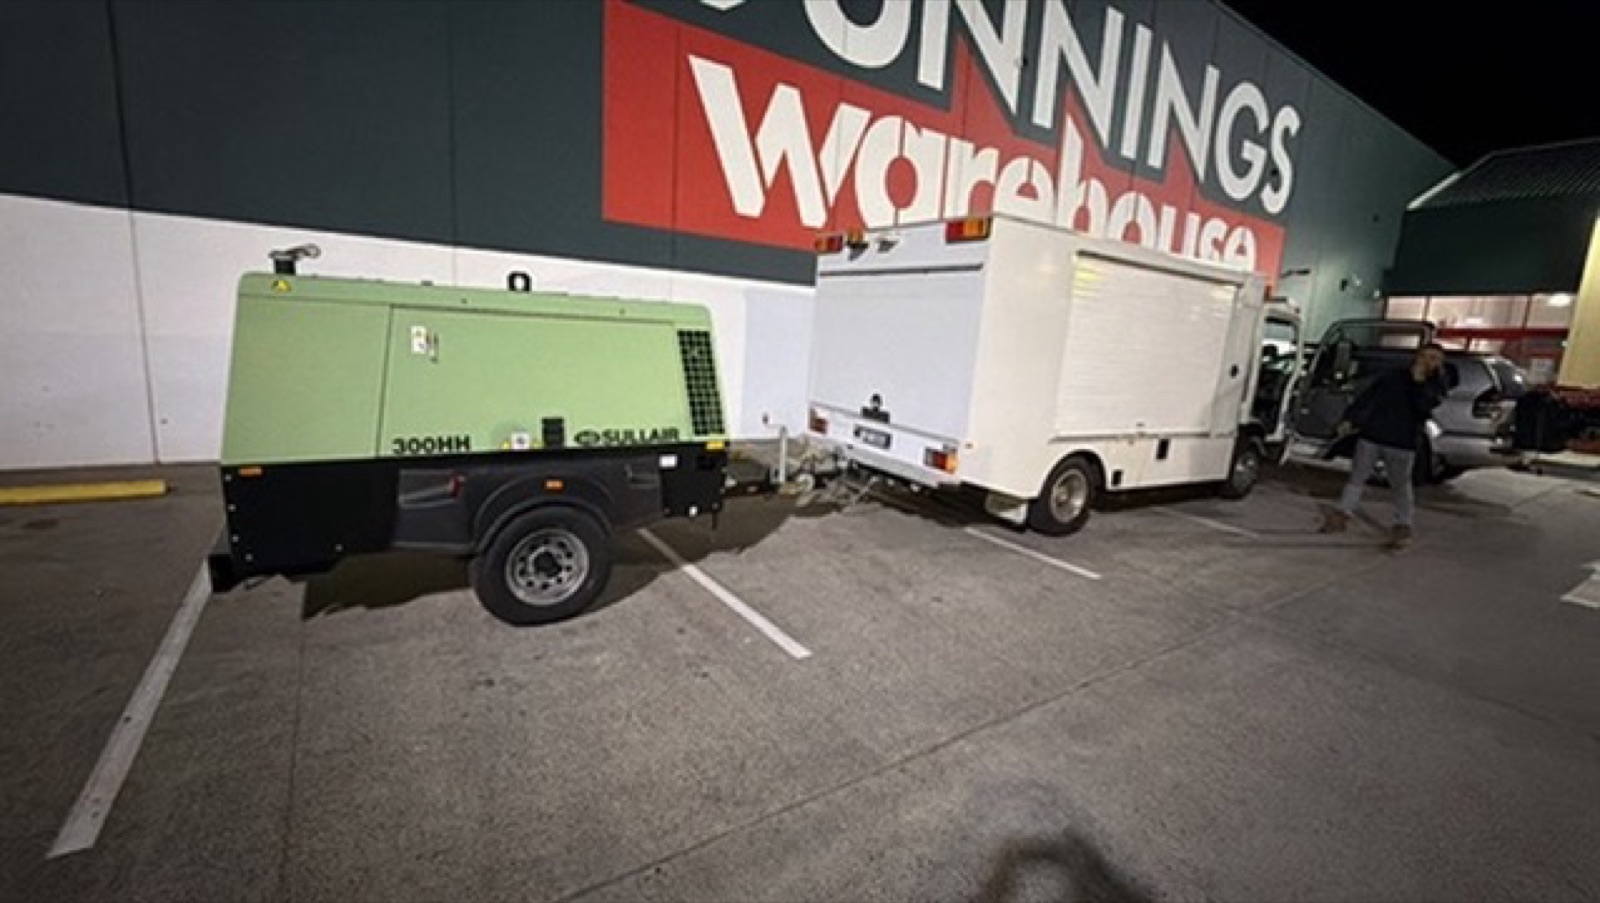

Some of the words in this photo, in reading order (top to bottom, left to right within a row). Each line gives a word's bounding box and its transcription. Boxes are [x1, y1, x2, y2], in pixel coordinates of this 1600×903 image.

[688, 54, 1257, 272] Warehouse
[698, 0, 1300, 214] NNINGS
[393, 435, 470, 454] 300HH
[602, 428, 680, 446] SULLAIR
